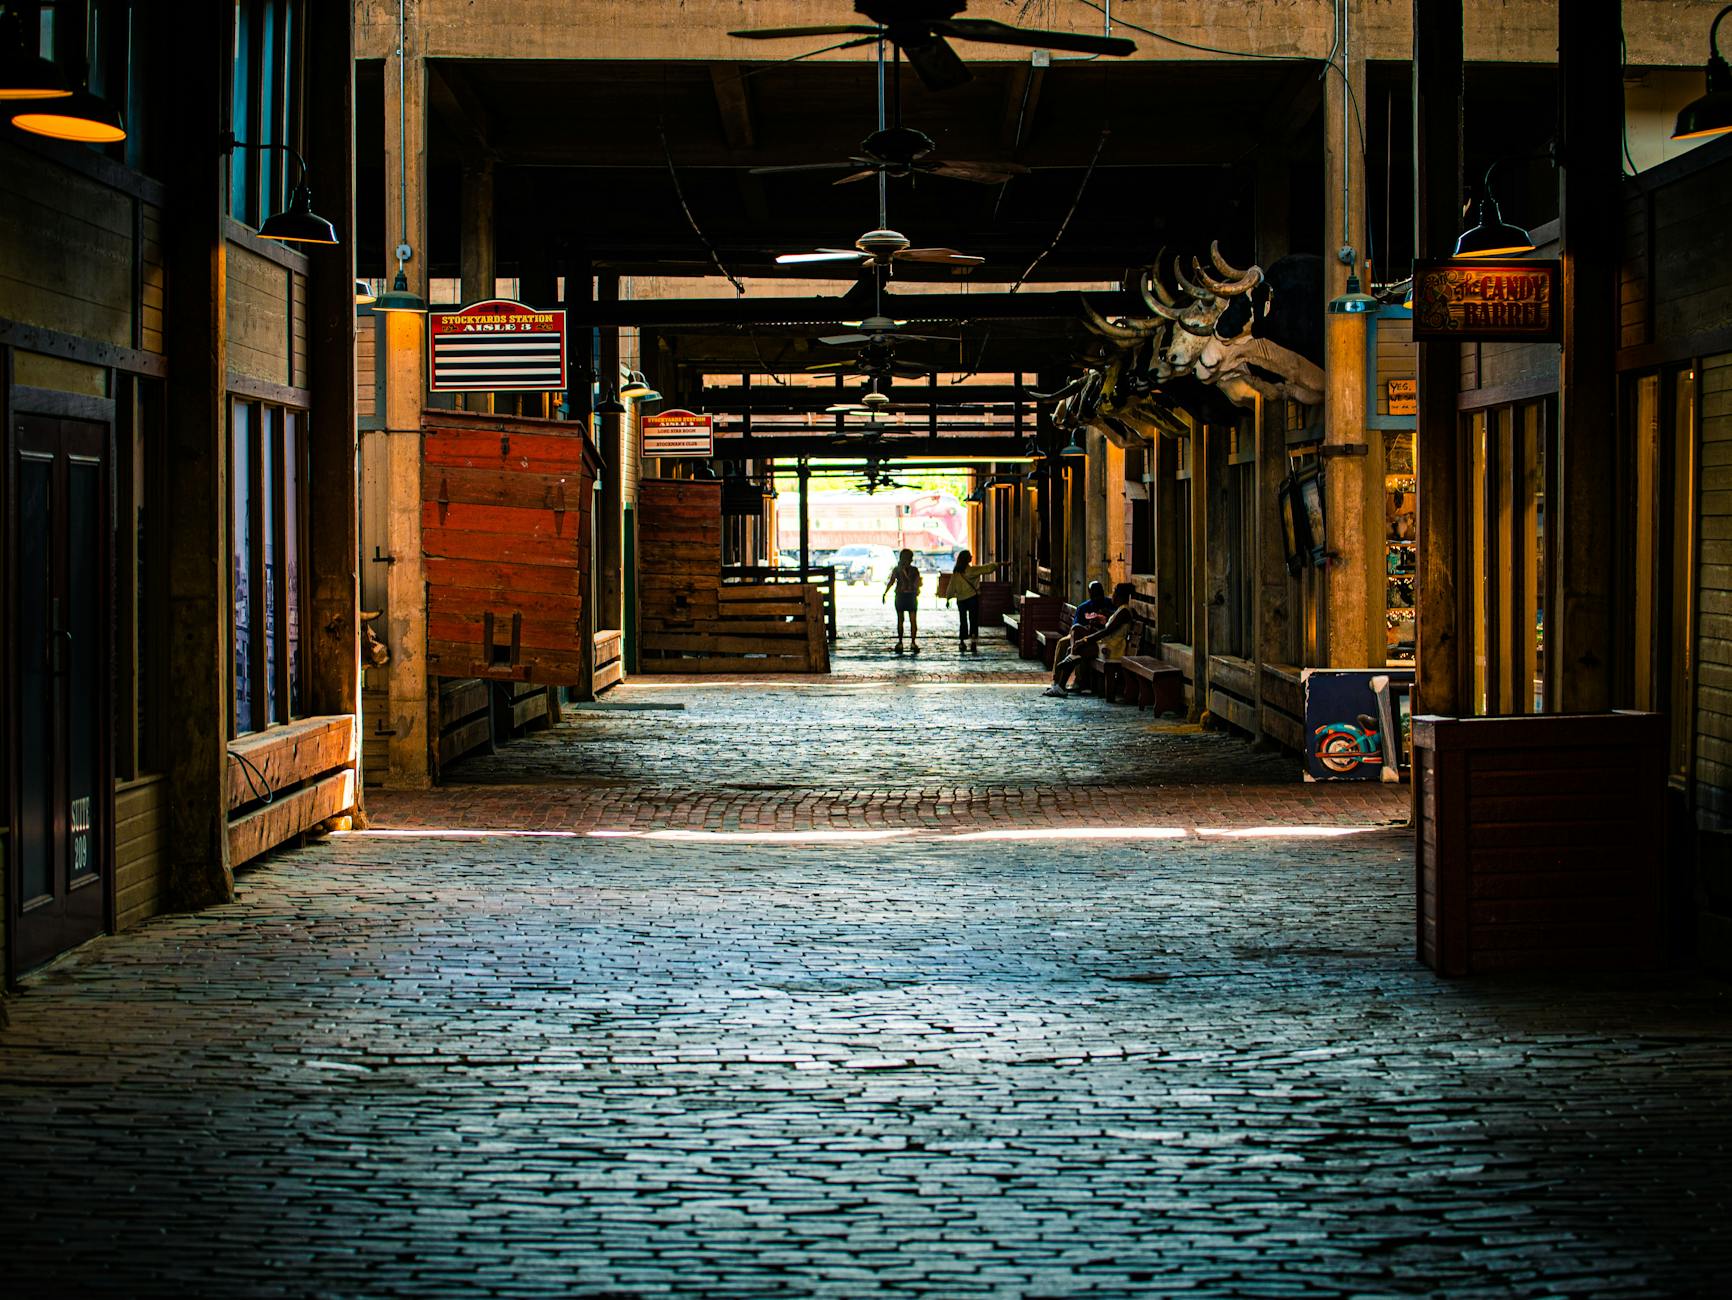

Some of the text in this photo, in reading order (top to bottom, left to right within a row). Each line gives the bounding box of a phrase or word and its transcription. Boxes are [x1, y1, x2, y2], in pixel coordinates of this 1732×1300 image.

[1480, 275, 1546, 301] CANDY
[442, 314, 553, 325] STOCKYARDS STATION
[463, 324, 517, 332] AISLE
[1464, 302, 1545, 328] BARREL
[71, 796, 90, 832] SUITE
[74, 834, 87, 870] 209
